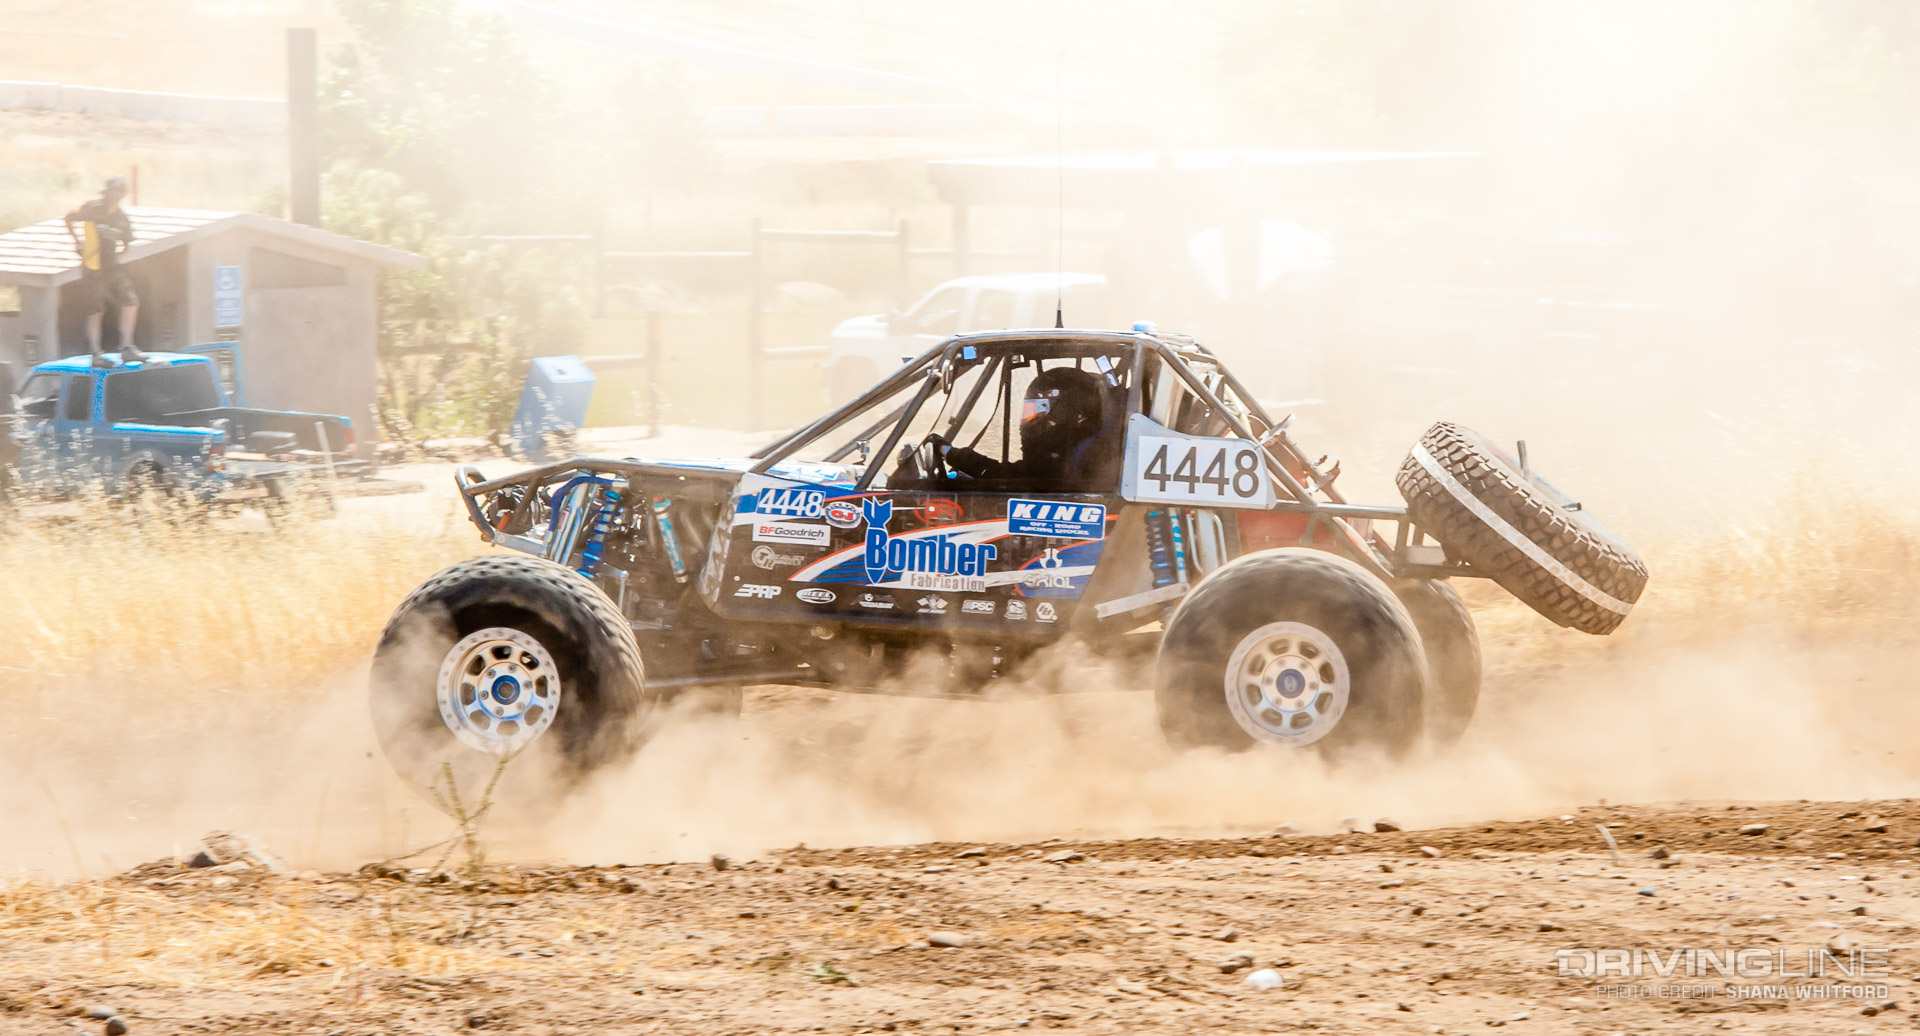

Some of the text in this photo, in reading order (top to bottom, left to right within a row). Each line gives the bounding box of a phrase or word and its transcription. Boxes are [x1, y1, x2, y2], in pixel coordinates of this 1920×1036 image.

[1143, 444, 1260, 498] 4448
[756, 488, 825, 517] 4448
[1011, 503, 1103, 523] KING
[759, 525, 824, 538] BFGoodrich
[864, 528, 998, 578] Bomber
[910, 574, 985, 591] Fabrication
